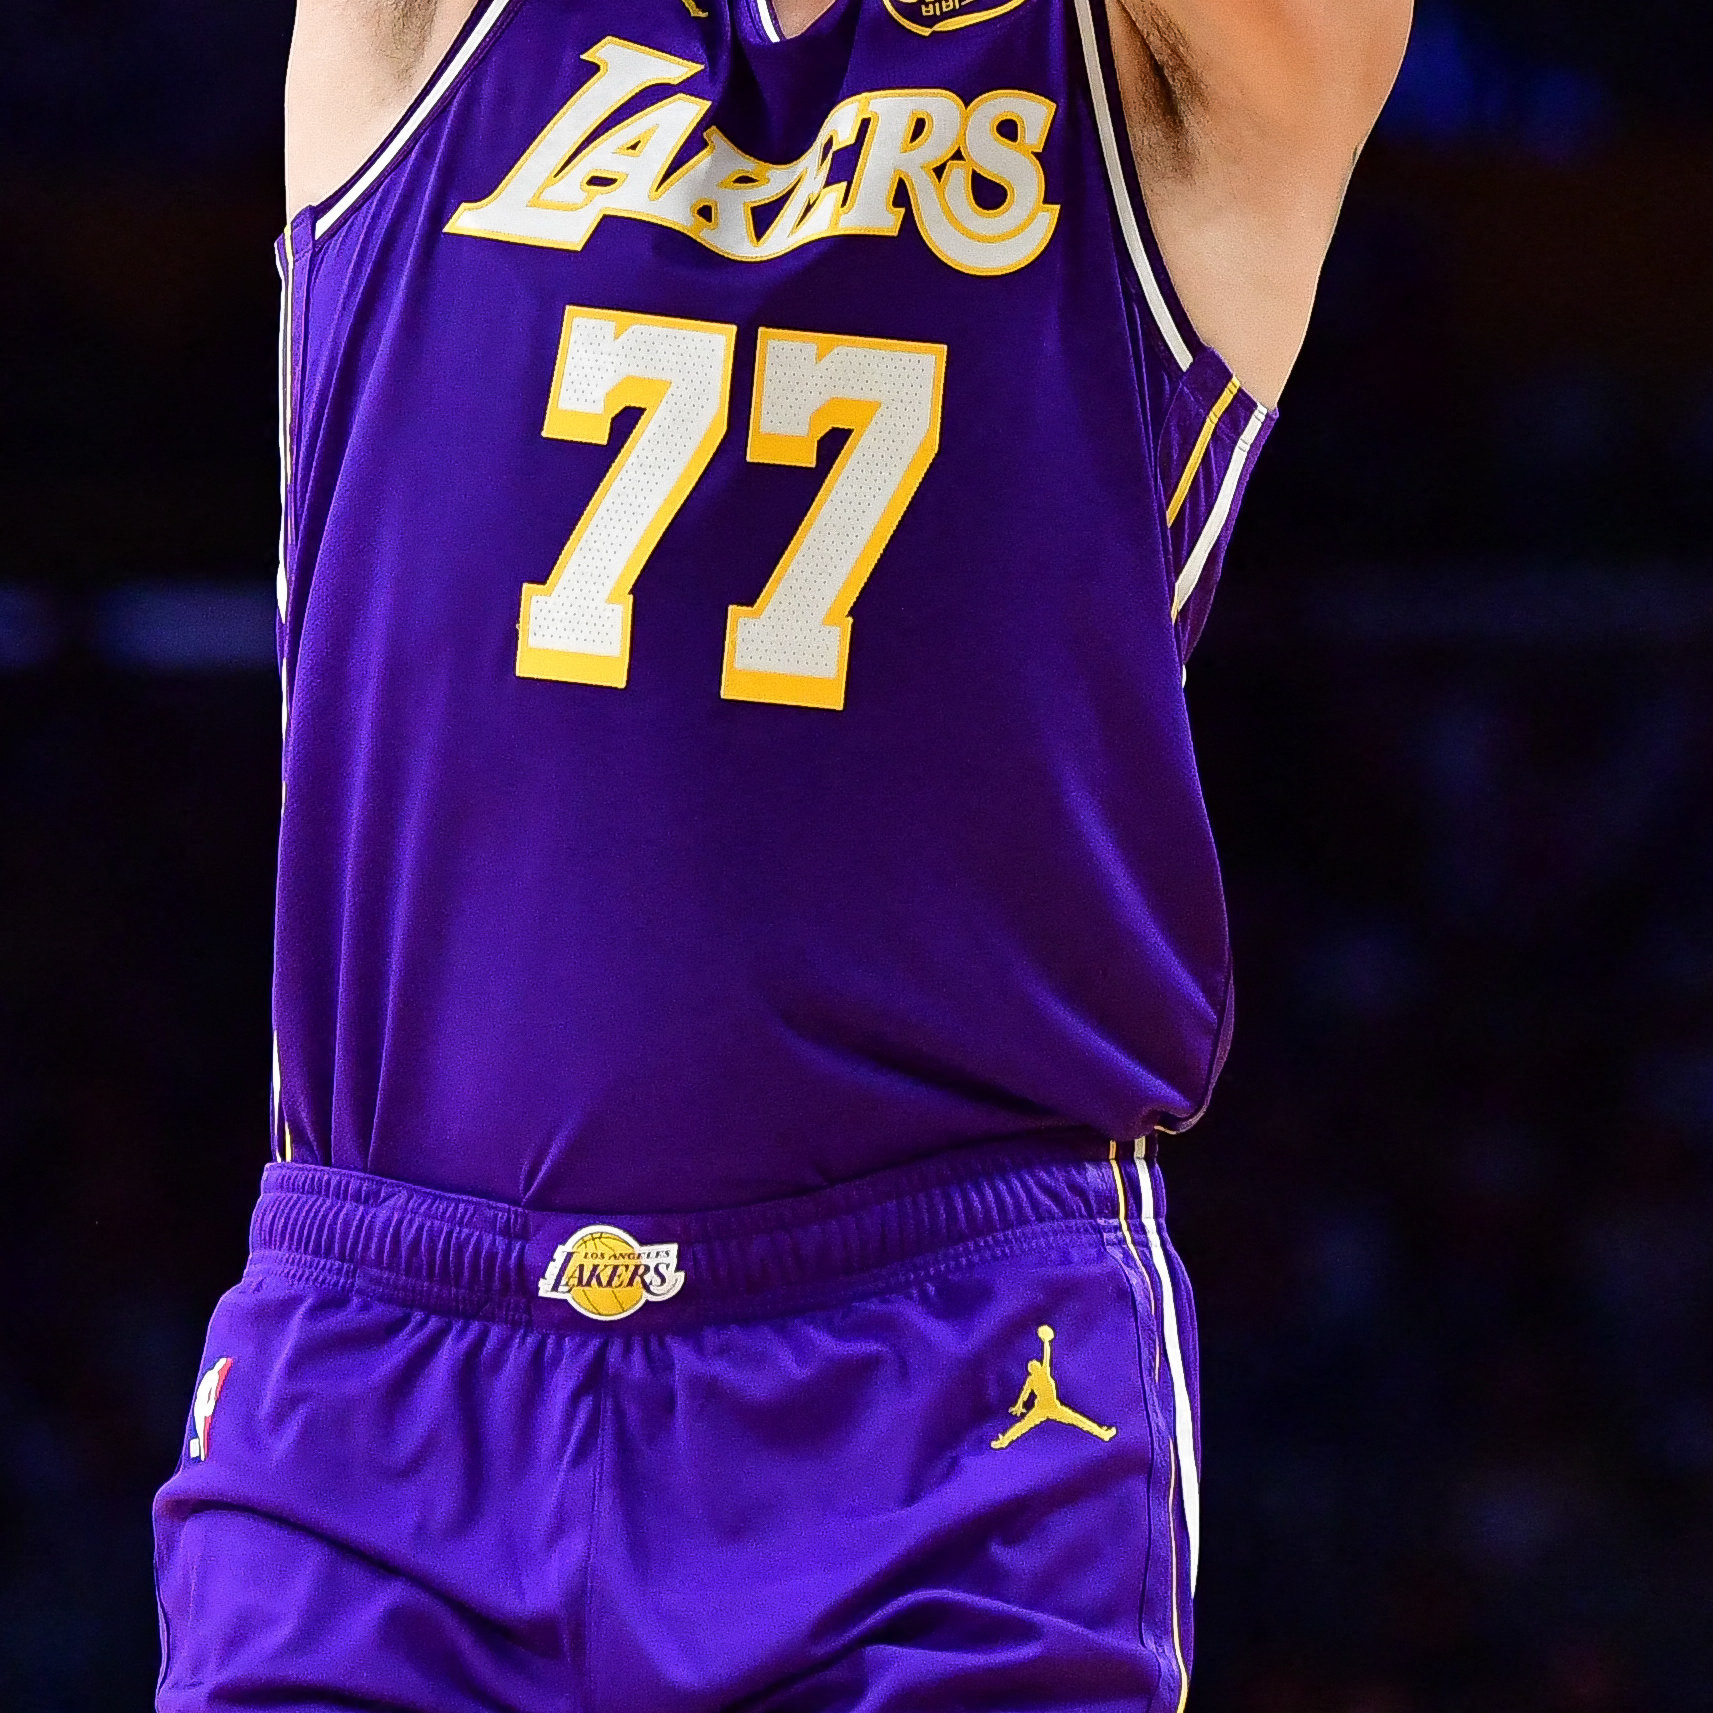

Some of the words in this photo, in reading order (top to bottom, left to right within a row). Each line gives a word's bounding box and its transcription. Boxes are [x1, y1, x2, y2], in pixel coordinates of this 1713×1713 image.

[444, 35, 1062, 277] LAKERS
[515, 304, 948, 711] 77
[546, 1250, 679, 1297] LAKERS
[583, 1251, 606, 1261] LOS
[608, 1249, 671, 1262] ANGELES
